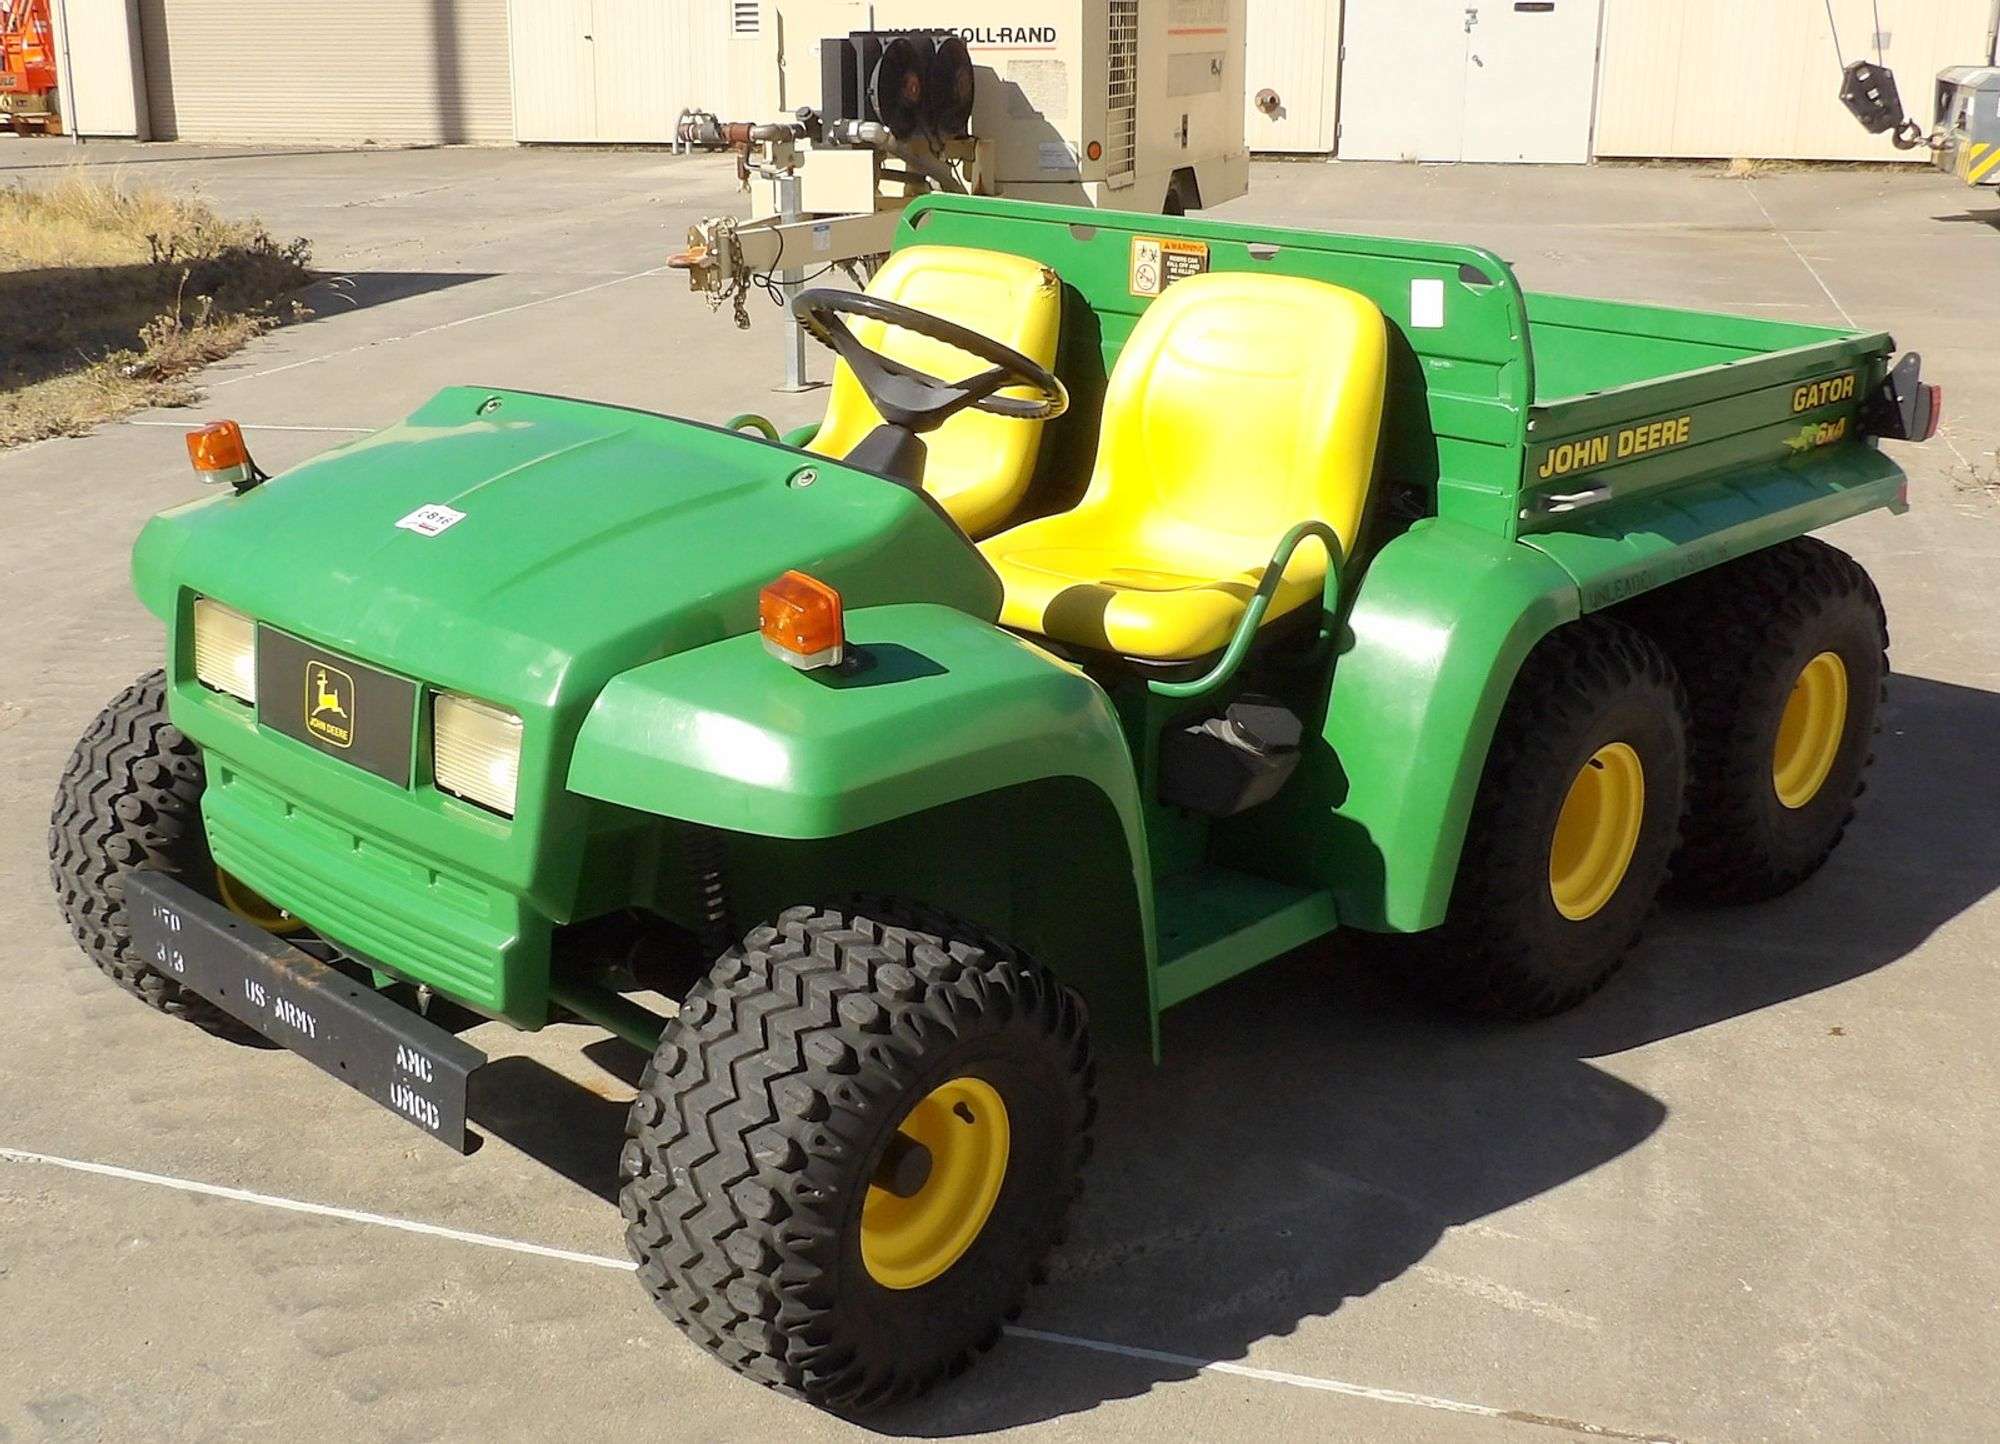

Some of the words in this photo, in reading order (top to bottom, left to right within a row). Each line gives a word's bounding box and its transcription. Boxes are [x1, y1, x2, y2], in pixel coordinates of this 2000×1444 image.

[1793, 374, 1856, 413] GATOR
[1538, 435, 1608, 479] JOHN
[1618, 416, 1691, 457] DEERE
[245, 978, 266, 1007] US
[275, 997, 316, 1039] ARMY
